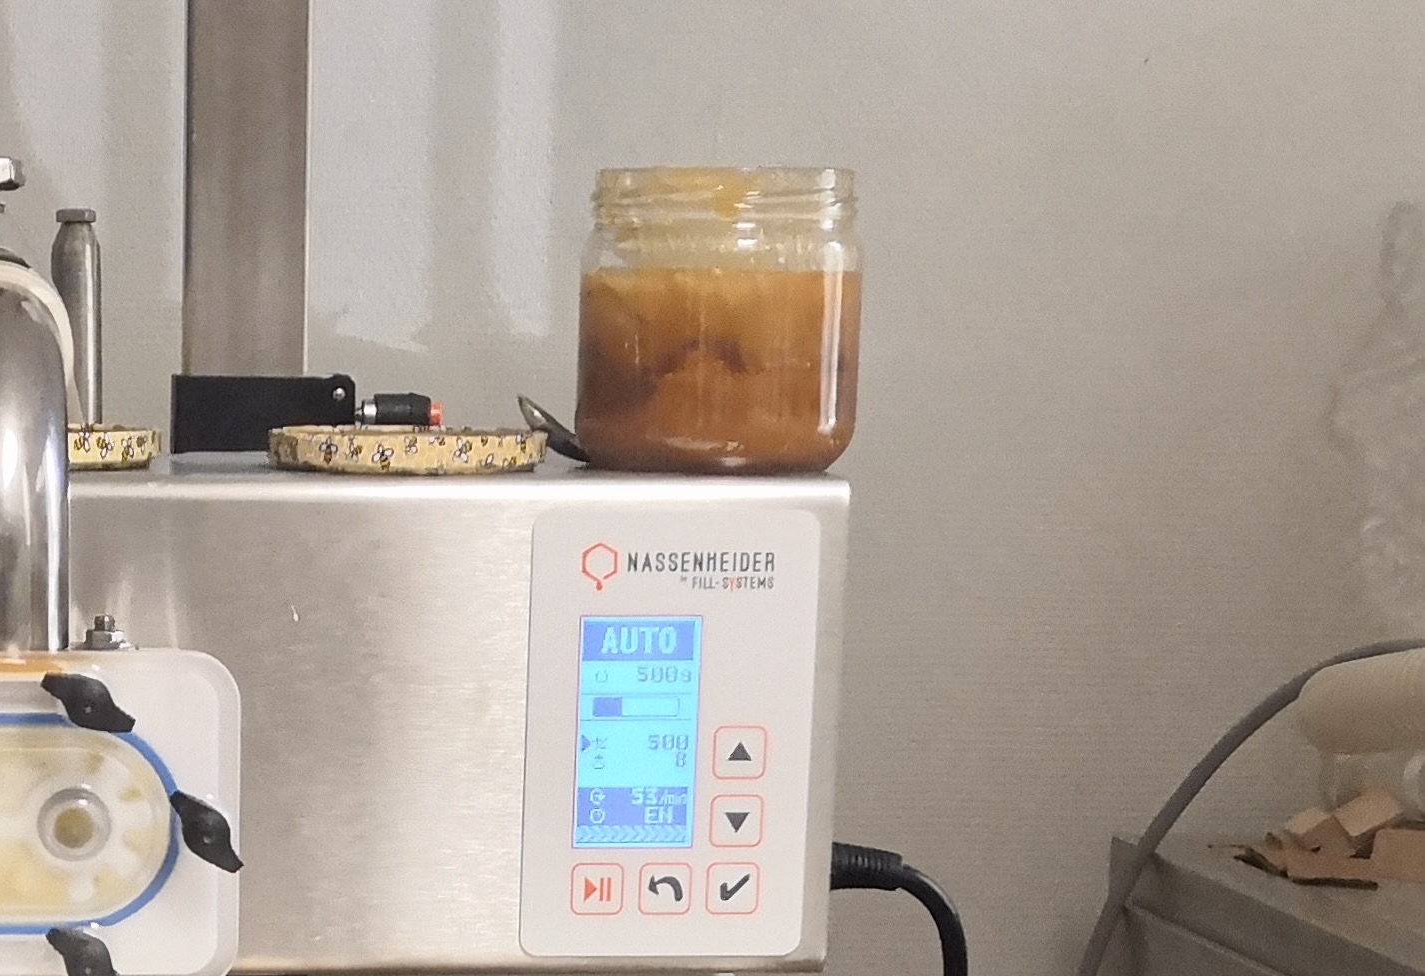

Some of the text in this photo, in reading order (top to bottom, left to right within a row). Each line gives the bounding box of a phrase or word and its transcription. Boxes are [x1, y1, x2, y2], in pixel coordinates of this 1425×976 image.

[627, 551, 776, 573] NASSENHEIDER
[601, 626, 677, 655] AUTO
[647, 734, 689, 751] 500
